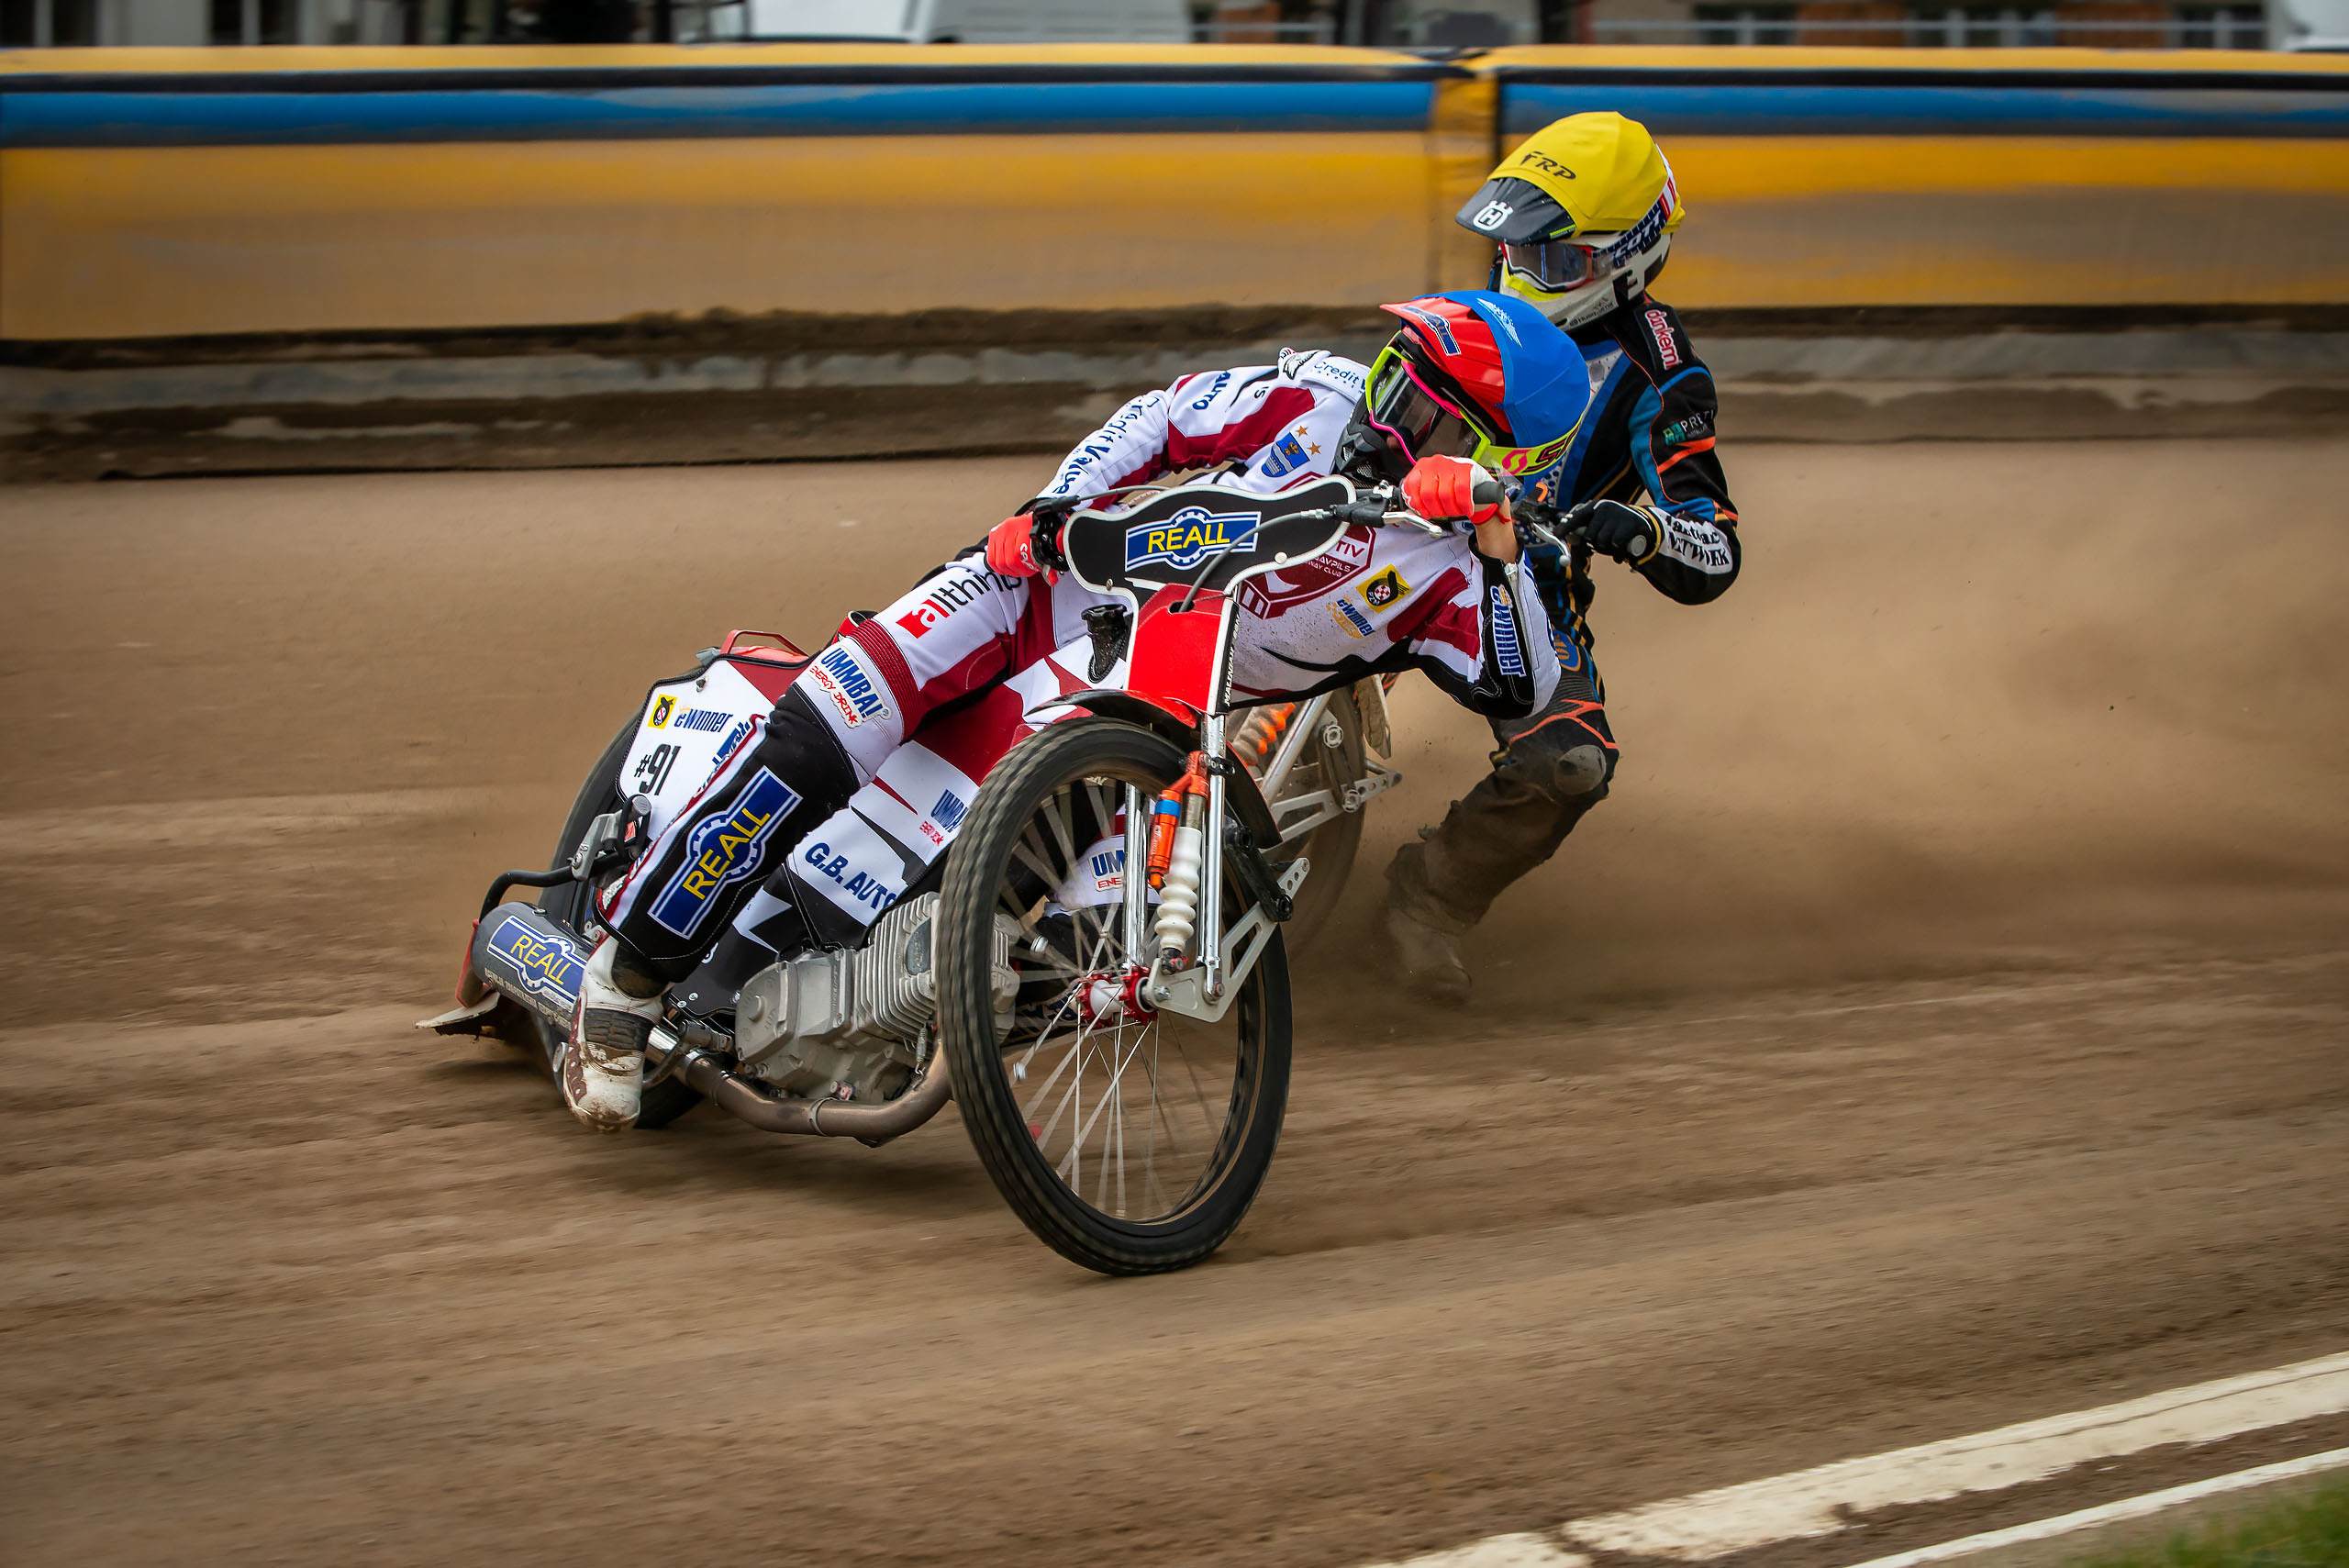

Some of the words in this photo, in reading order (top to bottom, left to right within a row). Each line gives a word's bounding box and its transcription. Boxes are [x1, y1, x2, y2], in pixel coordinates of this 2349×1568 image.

[1612, 210, 1662, 260] COTT
[1148, 522, 1231, 553] REALL
[682, 806, 771, 901] REALL
[805, 842, 848, 884] G.B.
[509, 934, 573, 985] REALL
